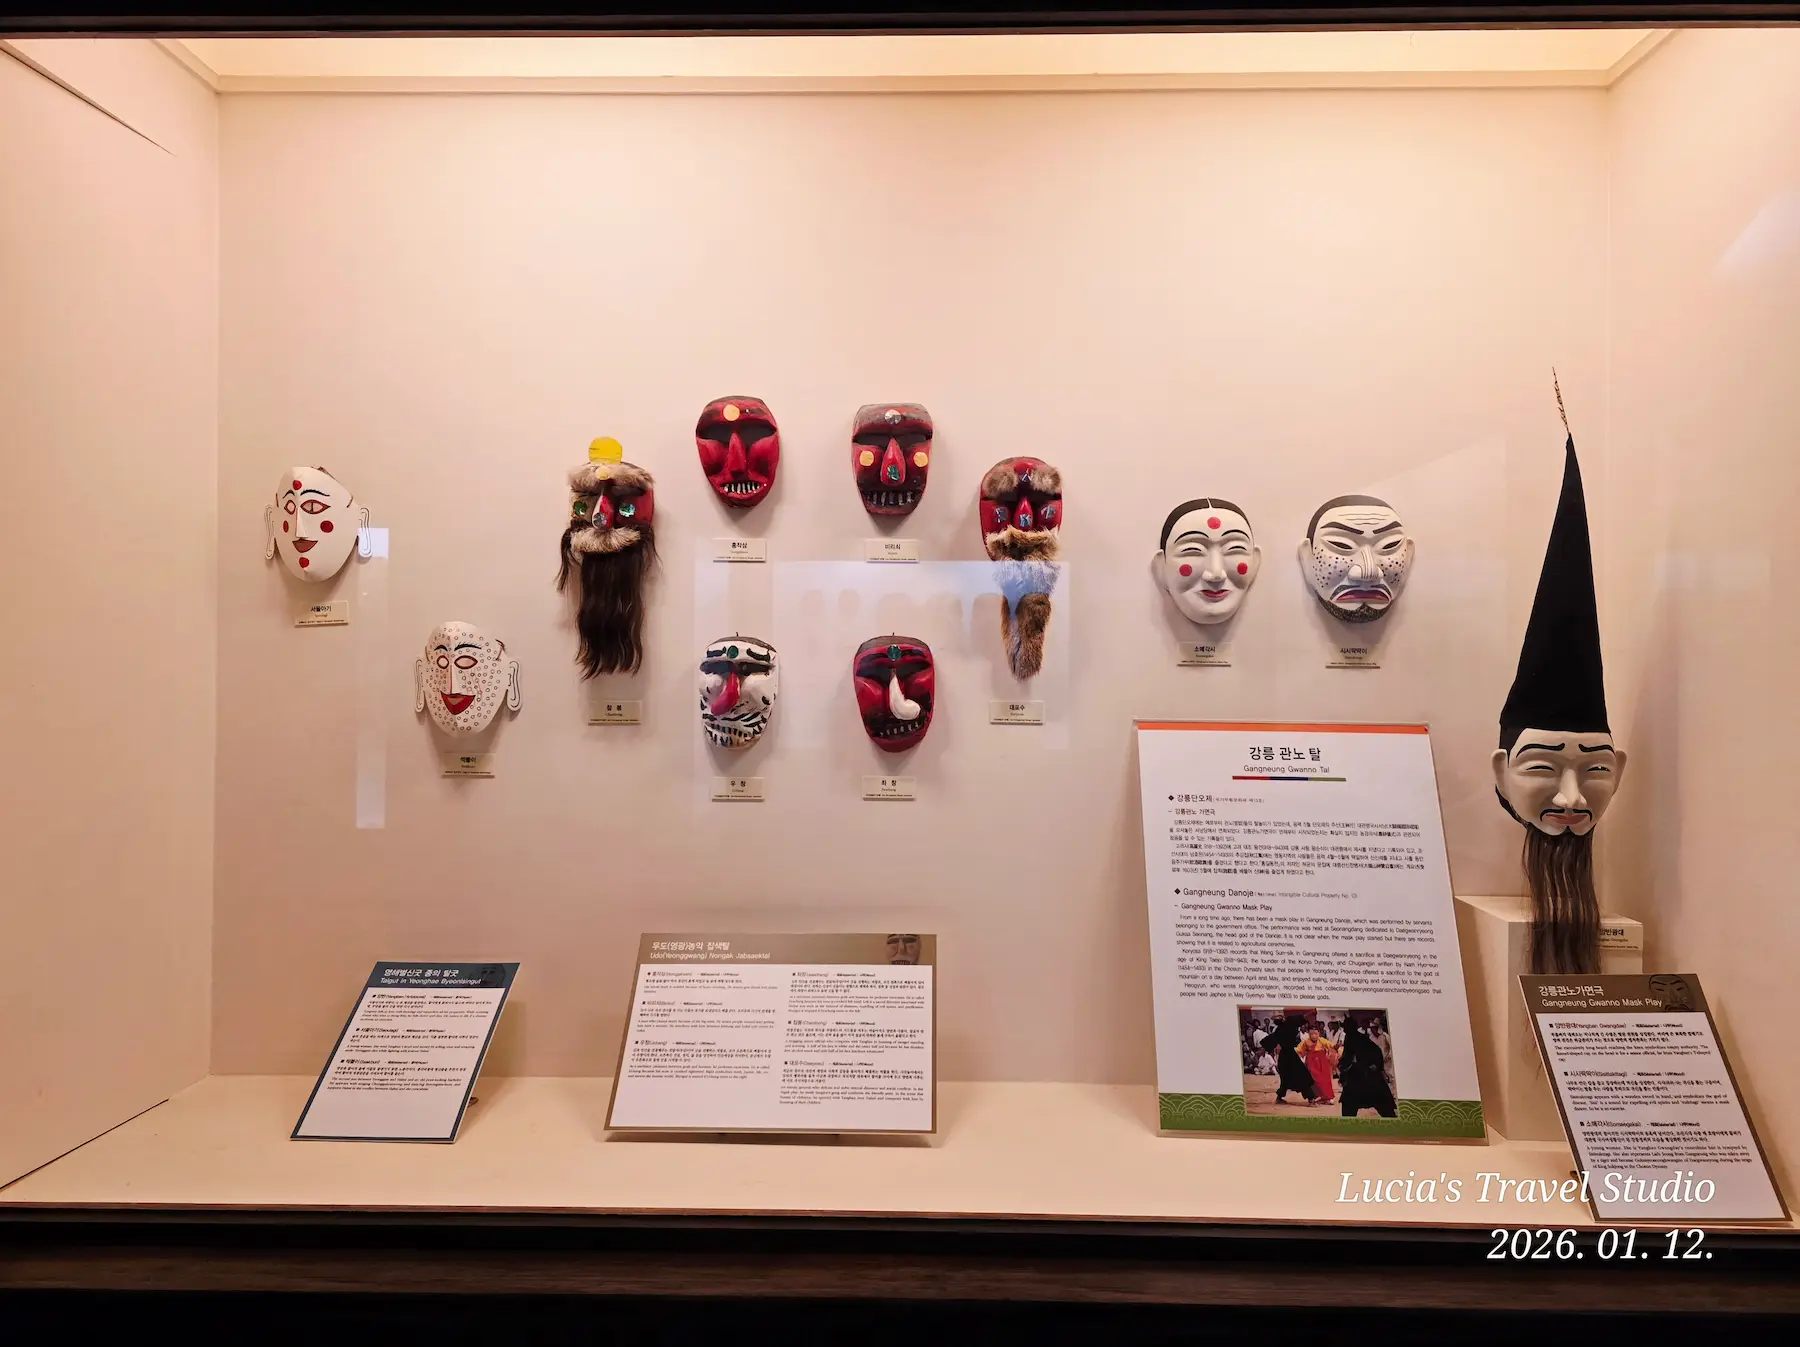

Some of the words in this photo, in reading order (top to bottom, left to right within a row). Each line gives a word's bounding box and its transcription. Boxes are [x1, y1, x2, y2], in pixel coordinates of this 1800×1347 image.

[1249, 747, 1274, 760] 강릉
[1280, 747, 1305, 760] 관노
[1309, 747, 1320, 761] 탈
[1244, 765, 1285, 773] Gangneung
[1183, 888, 1226, 897] Gangneung
[1228, 889, 1253, 898] Danoje
[709, 952, 734, 960] Nongak
[1539, 985, 1604, 996] 강릉관노가면극
[1542, 999, 1586, 1008] Gangneung
[1588, 999, 1620, 1007] Gwanno
[1622, 998, 1643, 1006] Mask
[1645, 998, 1662, 1008] Play
